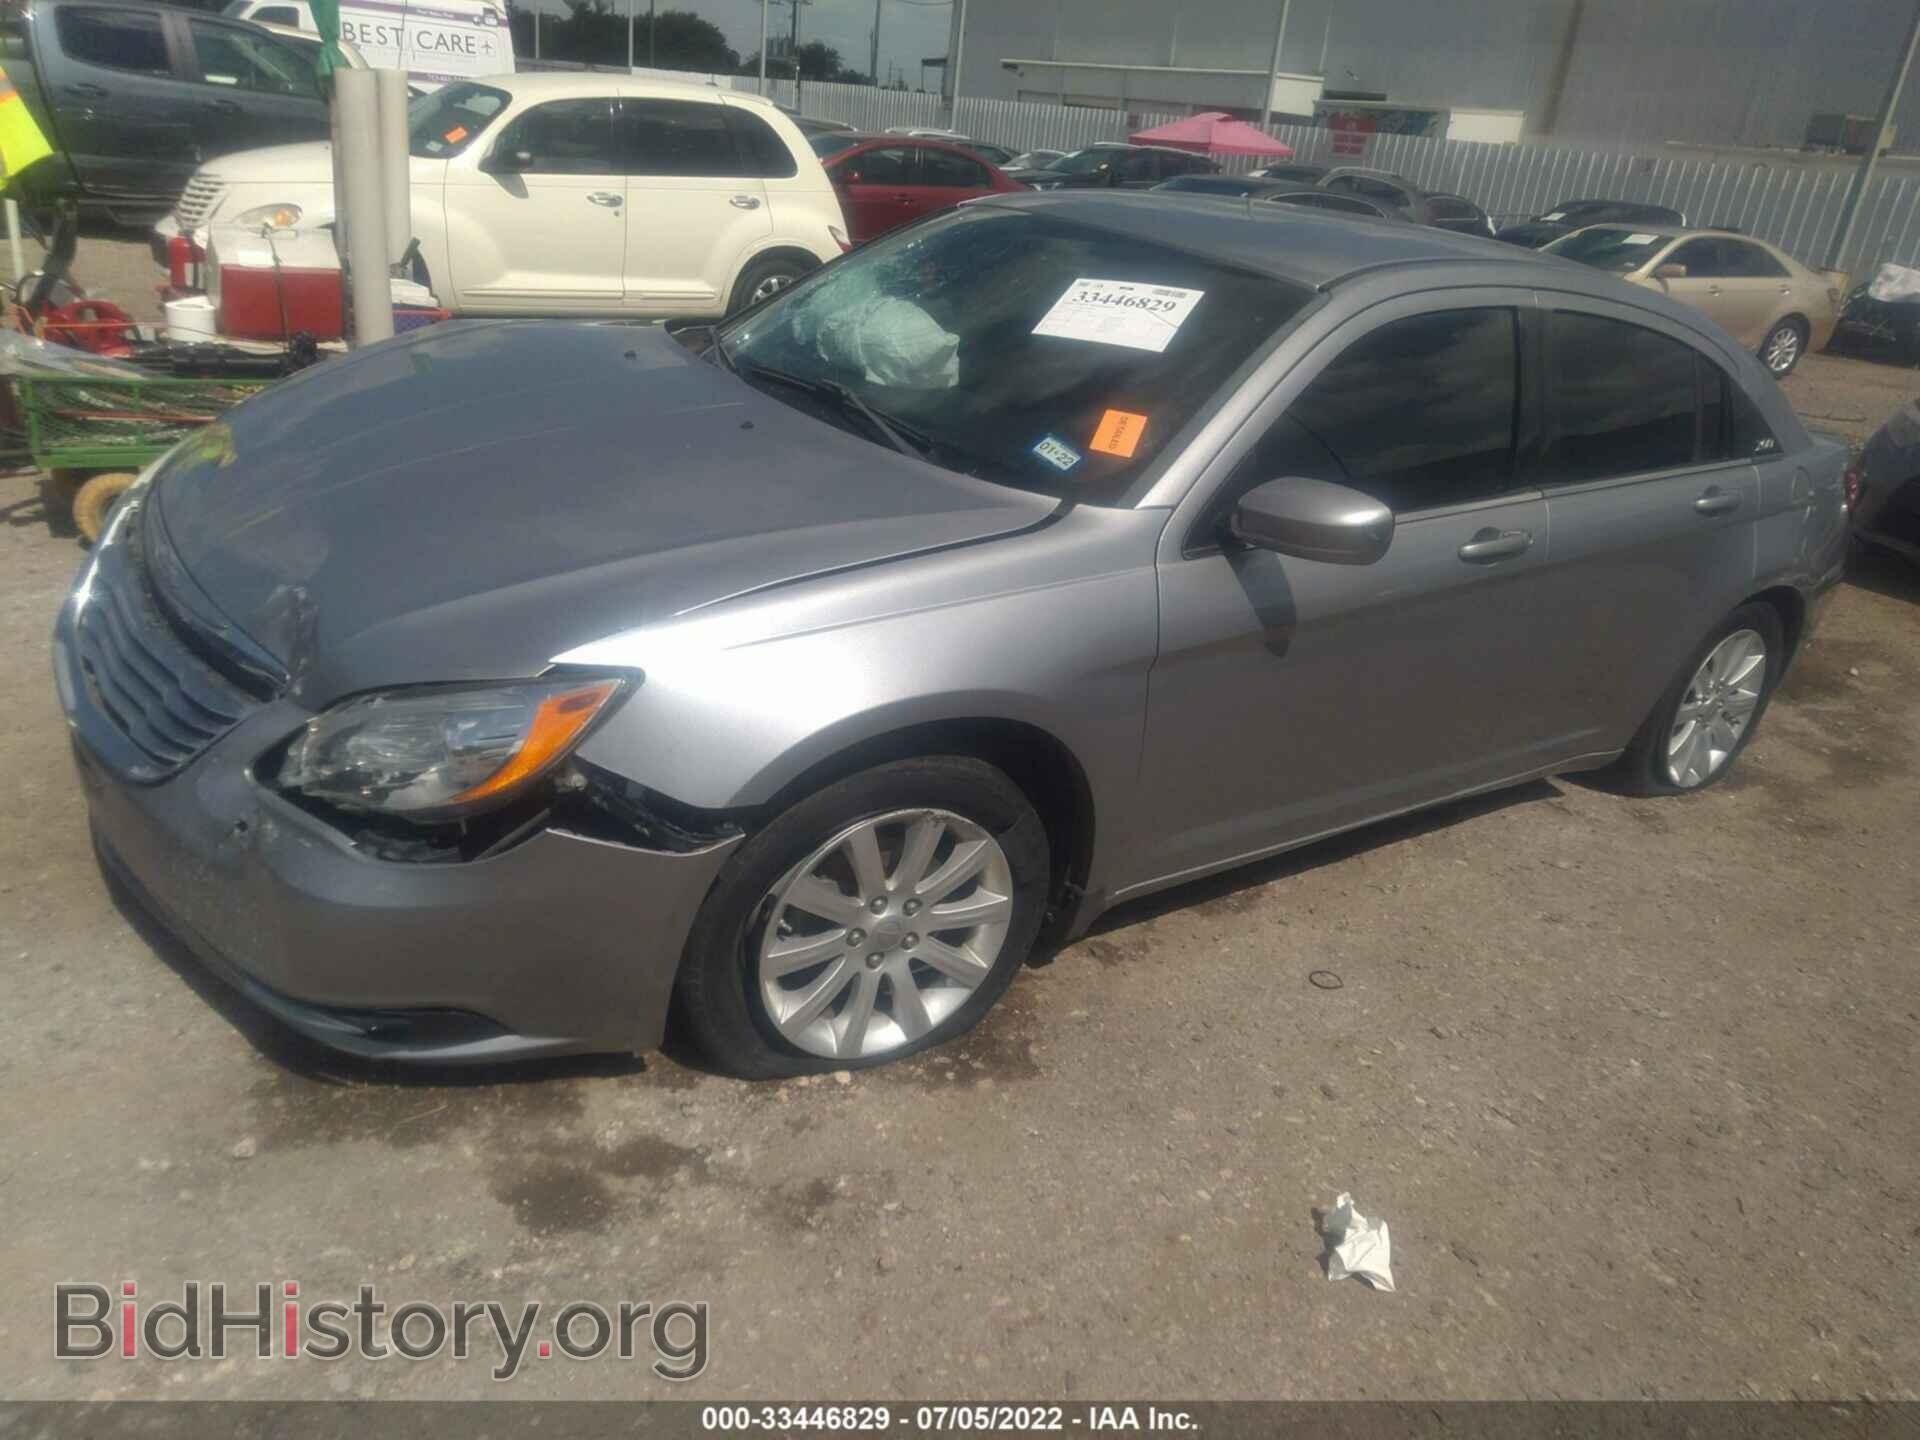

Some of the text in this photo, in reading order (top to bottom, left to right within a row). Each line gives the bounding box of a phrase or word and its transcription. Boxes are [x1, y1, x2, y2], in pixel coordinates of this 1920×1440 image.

[341, 22, 477, 54] BEST CARE
[1072, 290, 1177, 313] 33446829
